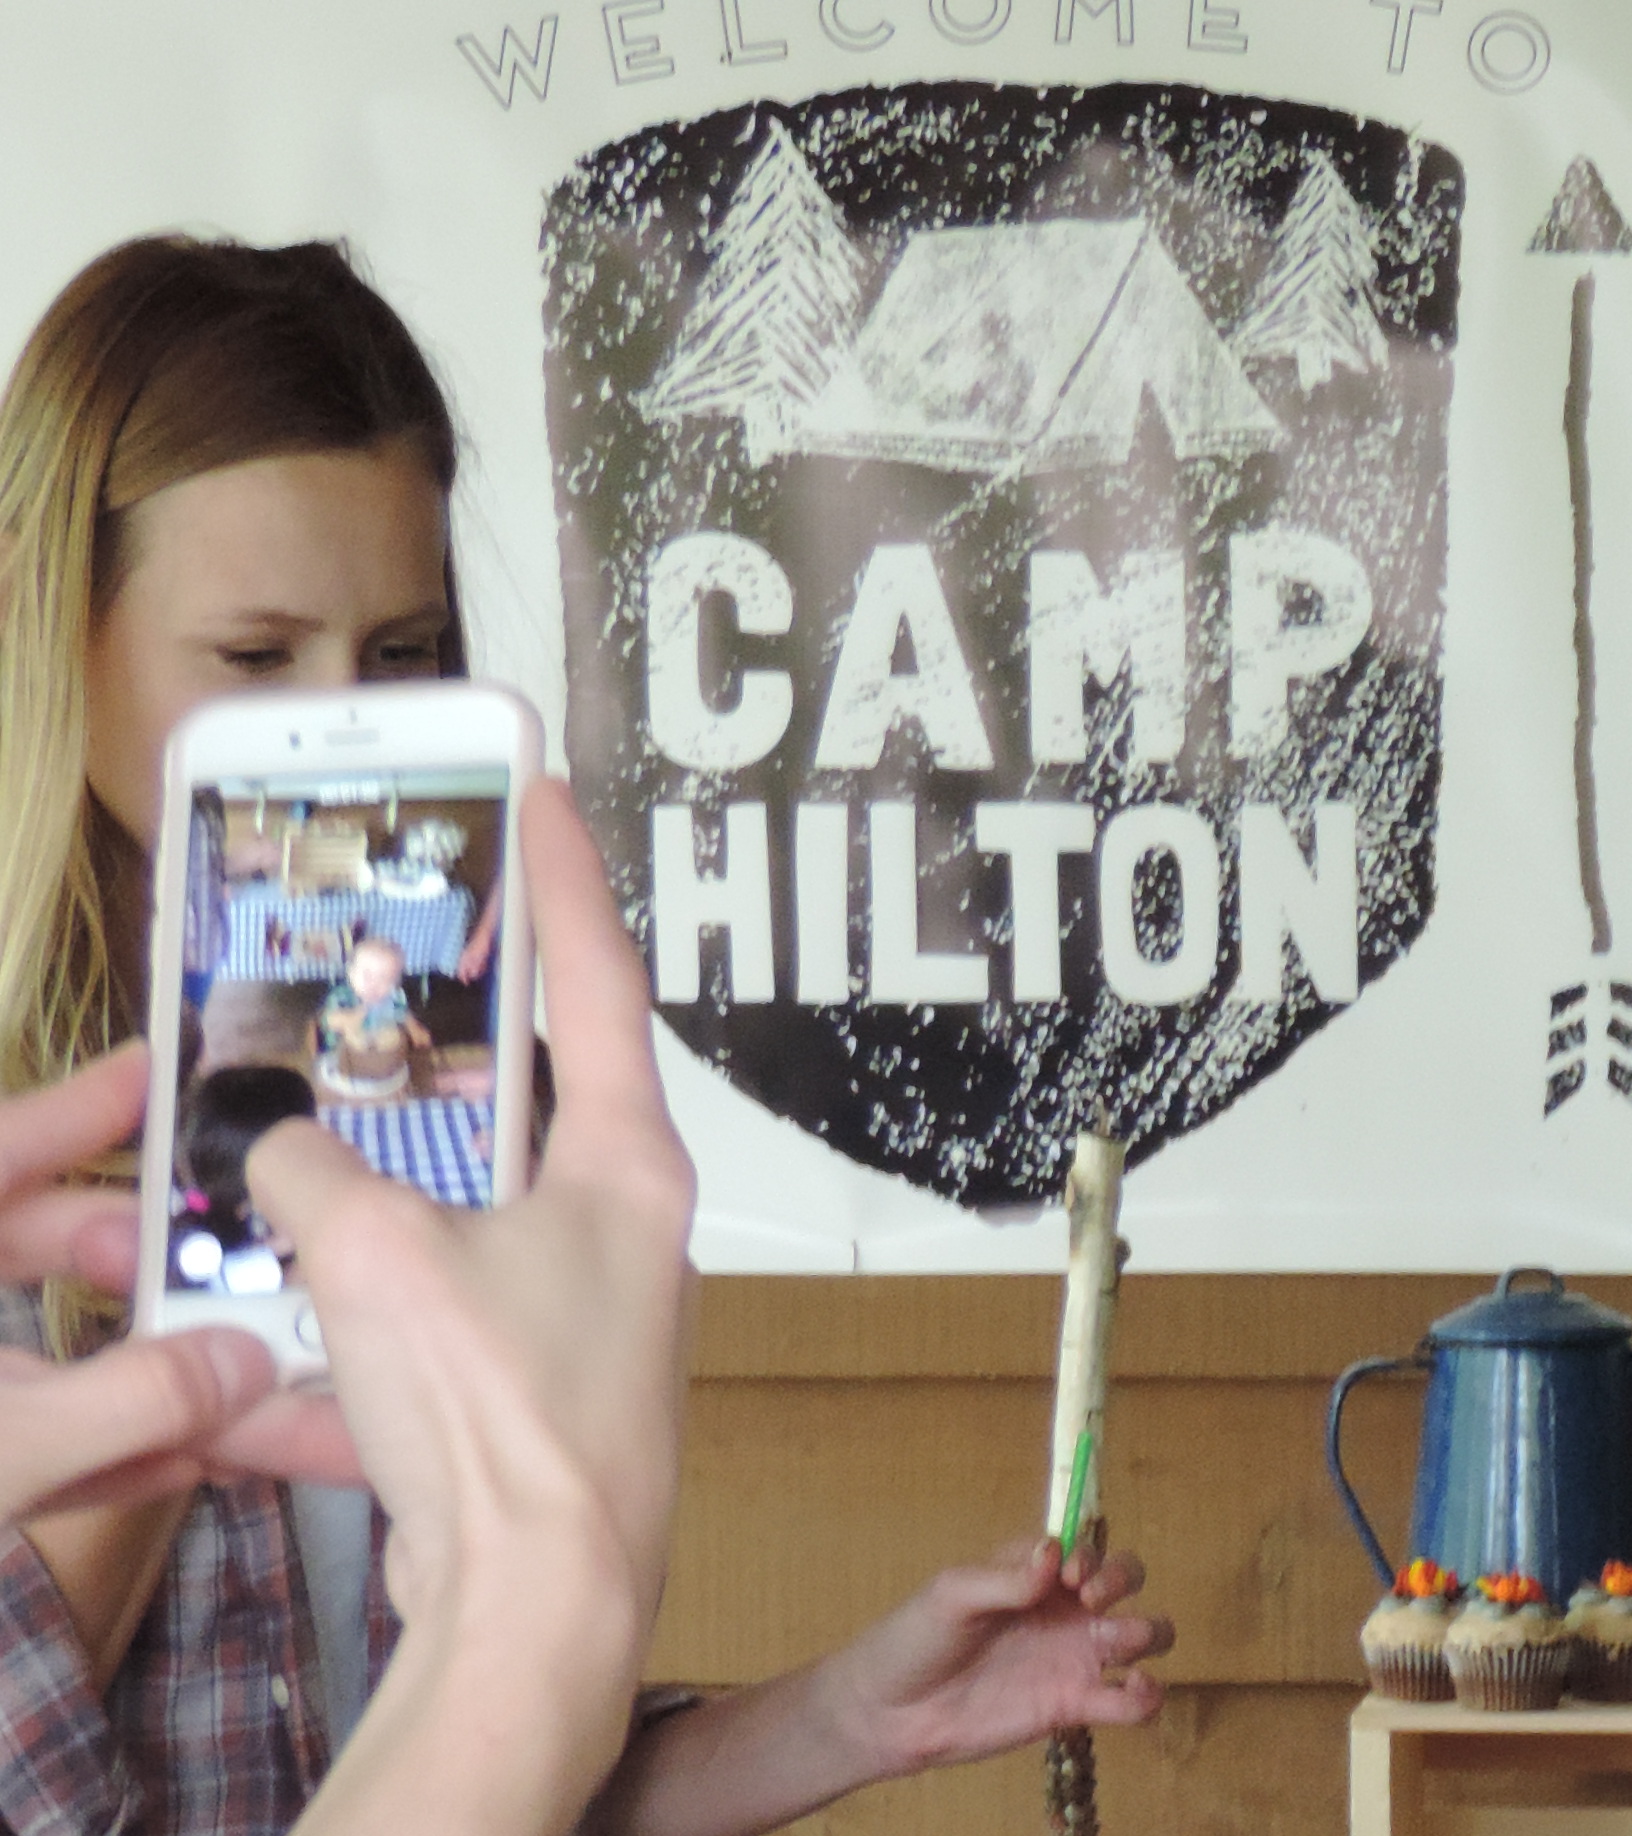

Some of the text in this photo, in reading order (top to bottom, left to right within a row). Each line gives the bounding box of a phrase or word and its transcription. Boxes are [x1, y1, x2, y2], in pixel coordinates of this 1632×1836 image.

[456, 0, 1552, 111] WELCOME TO
[646, 531, 1374, 772] CAMP
[650, 803, 1362, 1005] HILTON
